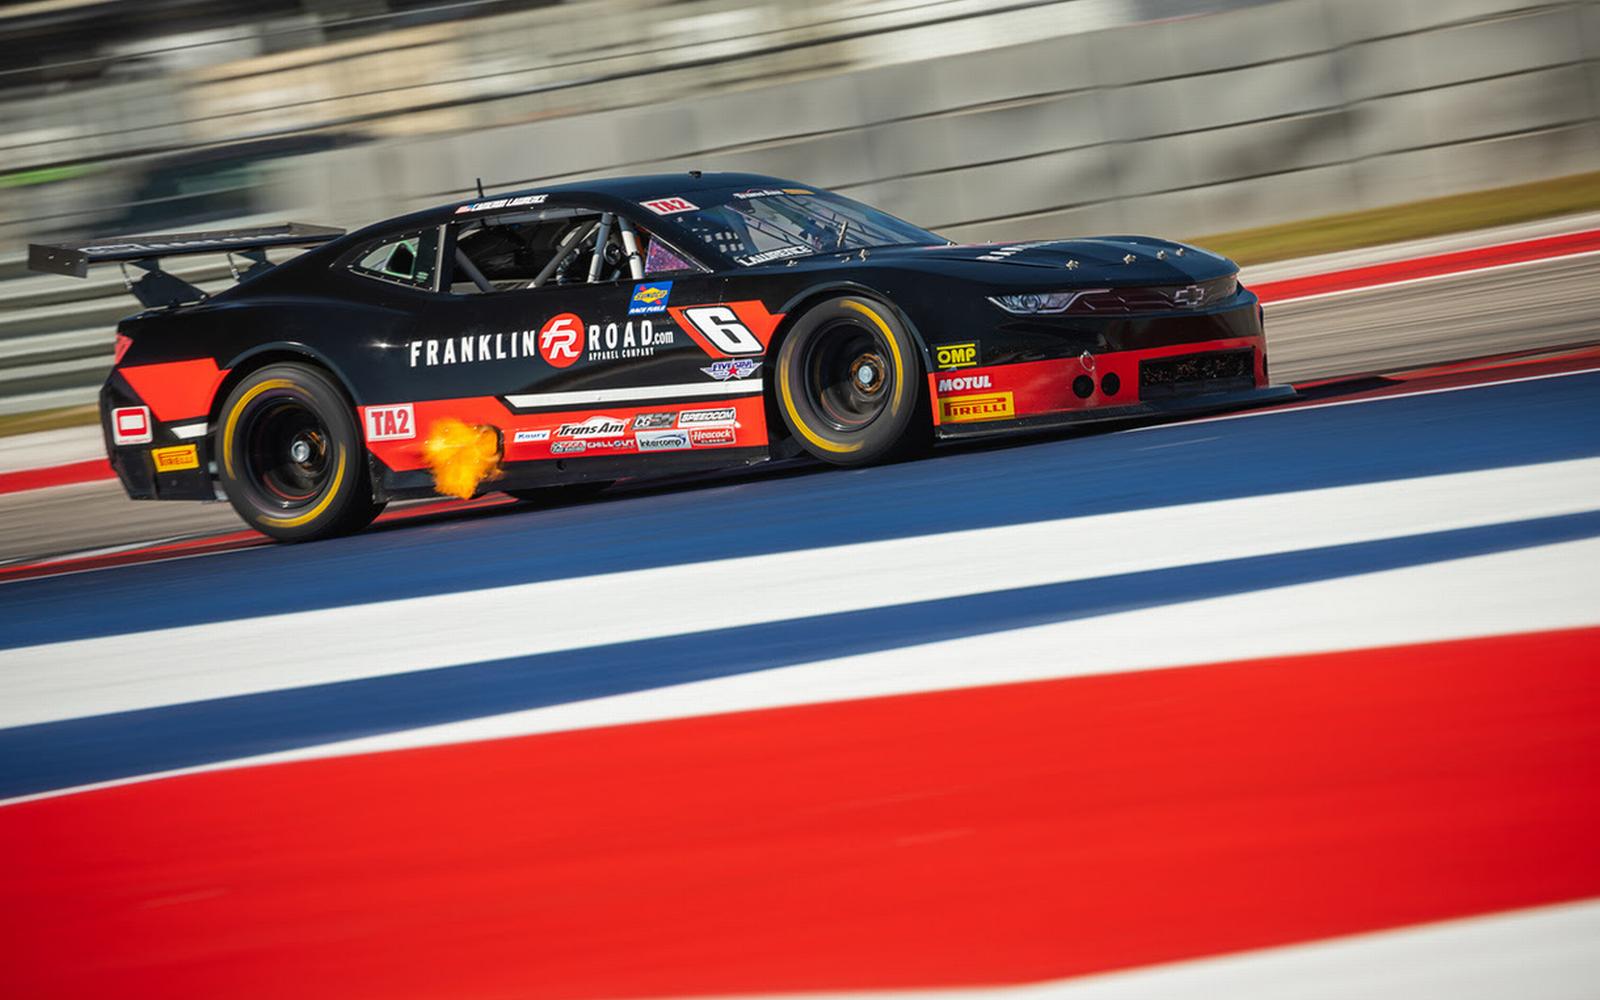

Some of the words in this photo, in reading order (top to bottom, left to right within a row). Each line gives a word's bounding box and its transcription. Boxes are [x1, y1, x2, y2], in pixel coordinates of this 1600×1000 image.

[650, 199, 692, 213] TA2
[634, 290, 668, 301] SUNOCO
[628, 307, 647, 315] RACE
[646, 305, 667, 313] FUELS
[684, 306, 766, 354] 6
[410, 330, 536, 367] FRANKLIN
[588, 348, 619, 361] APPAREL
[622, 347, 654, 358] COMPANY
[937, 347, 977, 364] OMP
[938, 375, 992, 392] MOTUL
[943, 398, 1007, 417] PIRELLI
[371, 409, 410, 436] TA2
[560, 424, 598, 436] Trans
[597, 422, 625, 434] Am
[693, 429, 732, 441] Heacock
